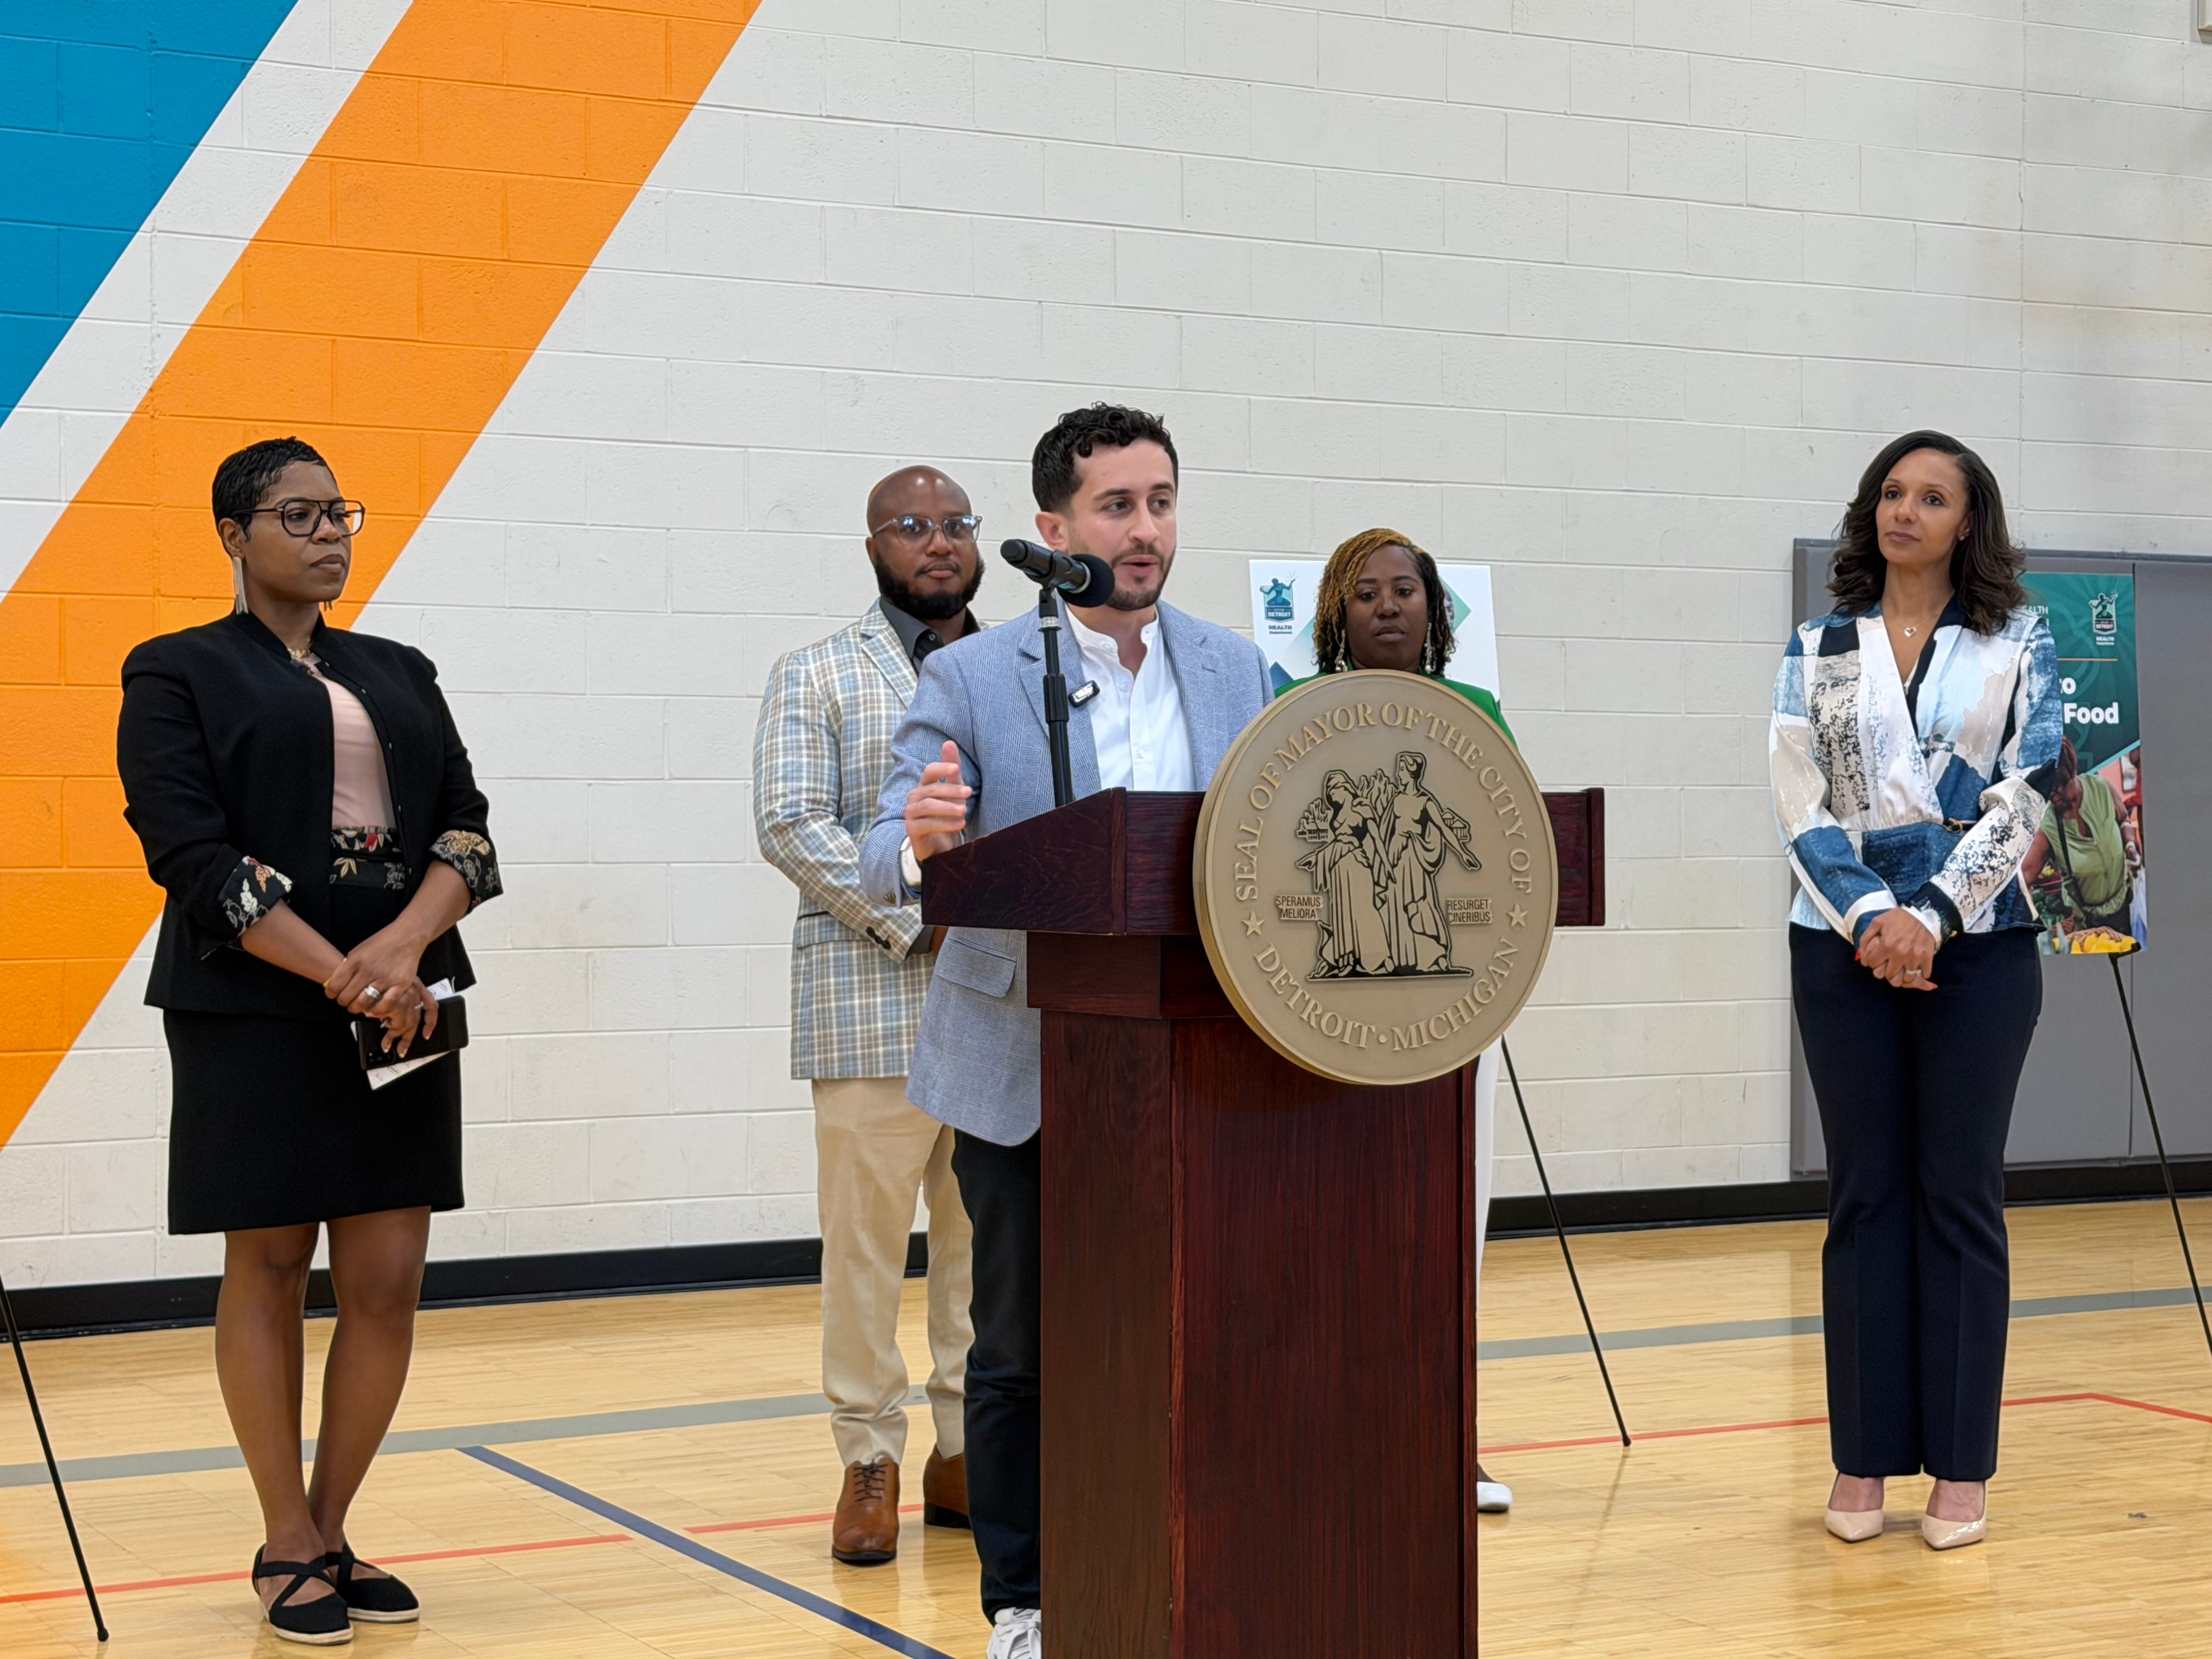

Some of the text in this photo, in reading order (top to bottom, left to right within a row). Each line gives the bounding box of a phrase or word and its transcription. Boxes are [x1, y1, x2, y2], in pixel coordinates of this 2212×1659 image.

[2064, 702, 2119, 724] Food
[1235, 701, 1533, 901] SEAL OF MAYOR OF THE CITY OF
[1276, 895, 1321, 907] SPERAMUS
[1446, 899, 1489, 910] RESURGET
[1280, 908, 1317, 919] MELIORA
[1448, 911, 1491, 923] CINERIBUS
[1253, 935, 1519, 1052] DETROIT MICHIGAN
